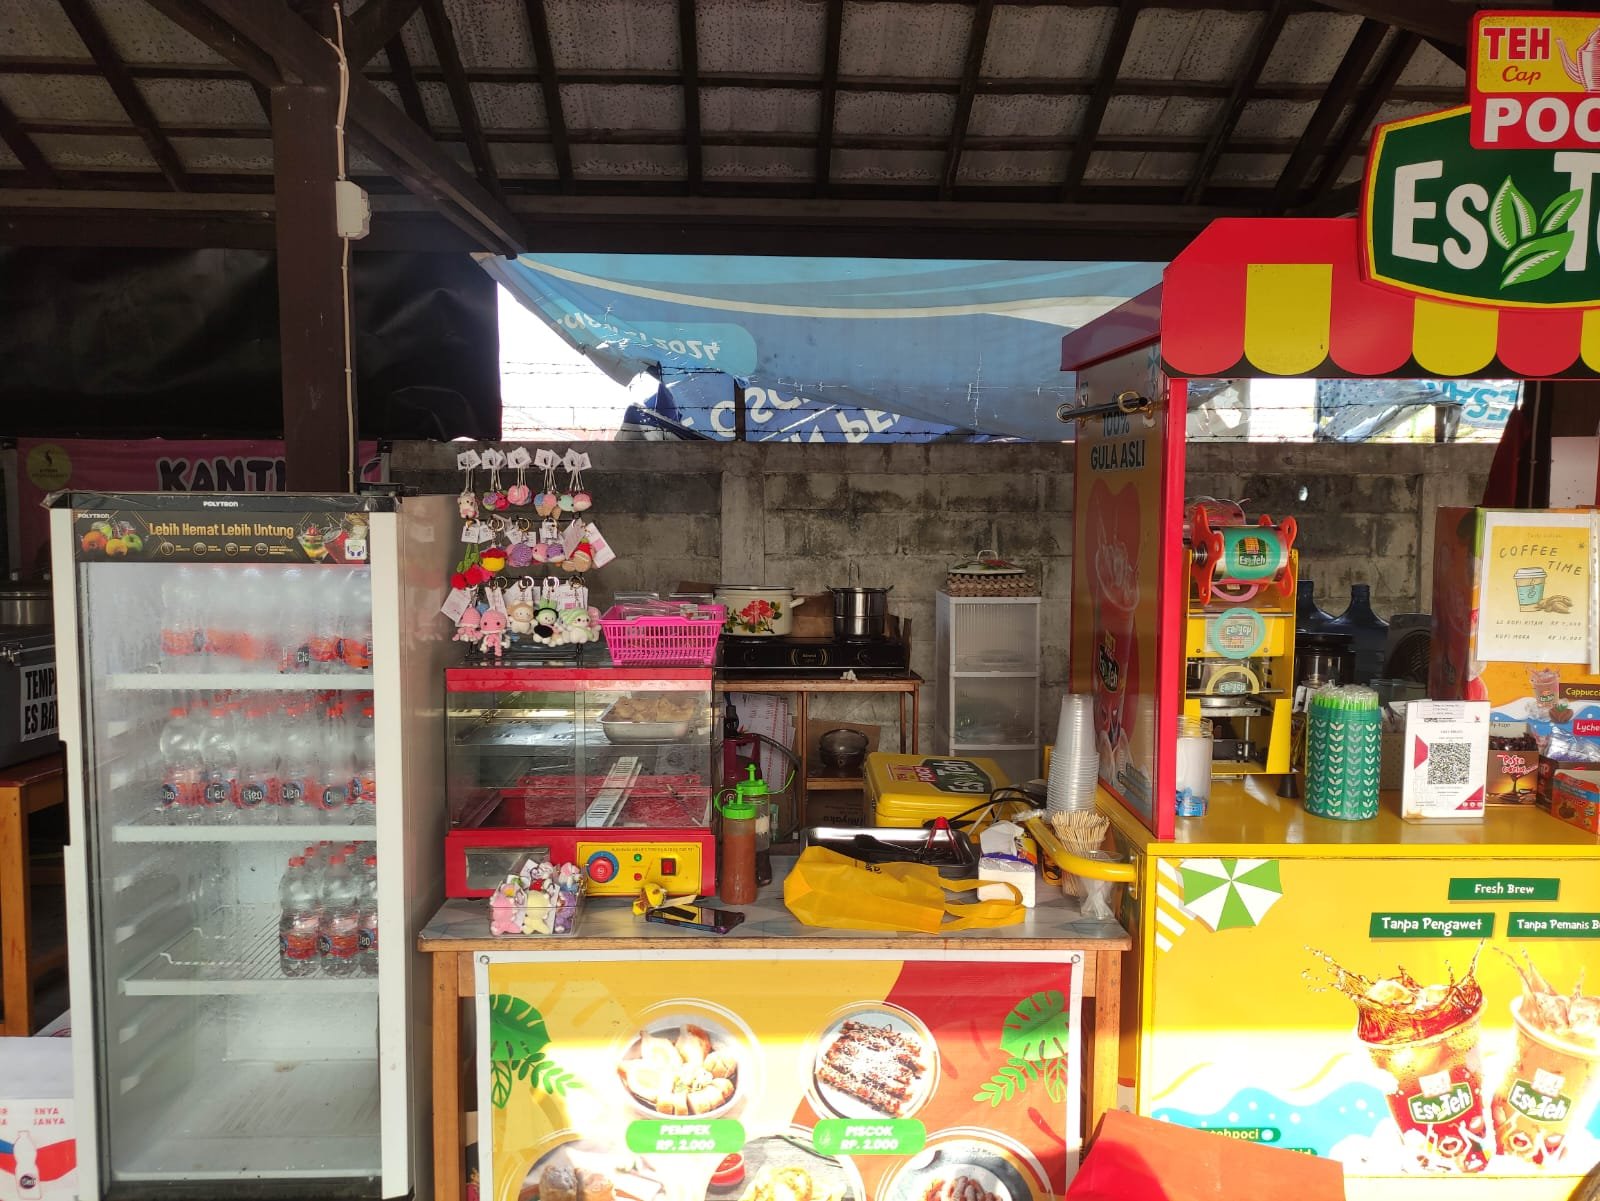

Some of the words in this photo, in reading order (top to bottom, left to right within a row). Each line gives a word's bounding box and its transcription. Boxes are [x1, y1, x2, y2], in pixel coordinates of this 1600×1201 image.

[1482, 26, 1551, 61] TEH
[1502, 64, 1542, 86] Cap
[1392, 159, 1489, 271] Es
[1553, 151, 1600, 272] T
[1102, 411, 1130, 438] 100%
[1090, 443, 1118, 471] GULA
[1120, 440, 1145, 468] ASLI
[149, 523, 180, 536] Lebih
[182, 523, 218, 537] Hemat
[221, 524, 251, 537] Lebih
[253, 524, 294, 539] Untung
[1499, 544, 1558, 559] COFFEE
[1547, 560, 1583, 576] TIME
[25, 704, 38, 735] ES
[915, 766, 936, 782] POCI
[933, 760, 978, 776] Teh
[1474, 881, 1504, 894] Fresh
[1507, 883, 1534, 894] Brew
[1382, 917, 1419, 933] Tanpa
[1422, 917, 1483, 936] Pengawet
[1516, 919, 1547, 932] Tanpa
[1550, 919, 1589, 929] Pemanis
[1411, 1100, 1434, 1120] Es
[1439, 1088, 1471, 1115] Teh
[1510, 1085, 1531, 1110] Es
[1537, 1095, 1568, 1121] Teh
[659, 1124, 711, 1135] PEMPEK
[845, 1125, 894, 1137] PISCOK
[655, 1139, 678, 1151] RP.
[679, 1138, 715, 1151] 2.000
[840, 1139, 861, 1150] RP.
[863, 1139, 899, 1150] 2.000
